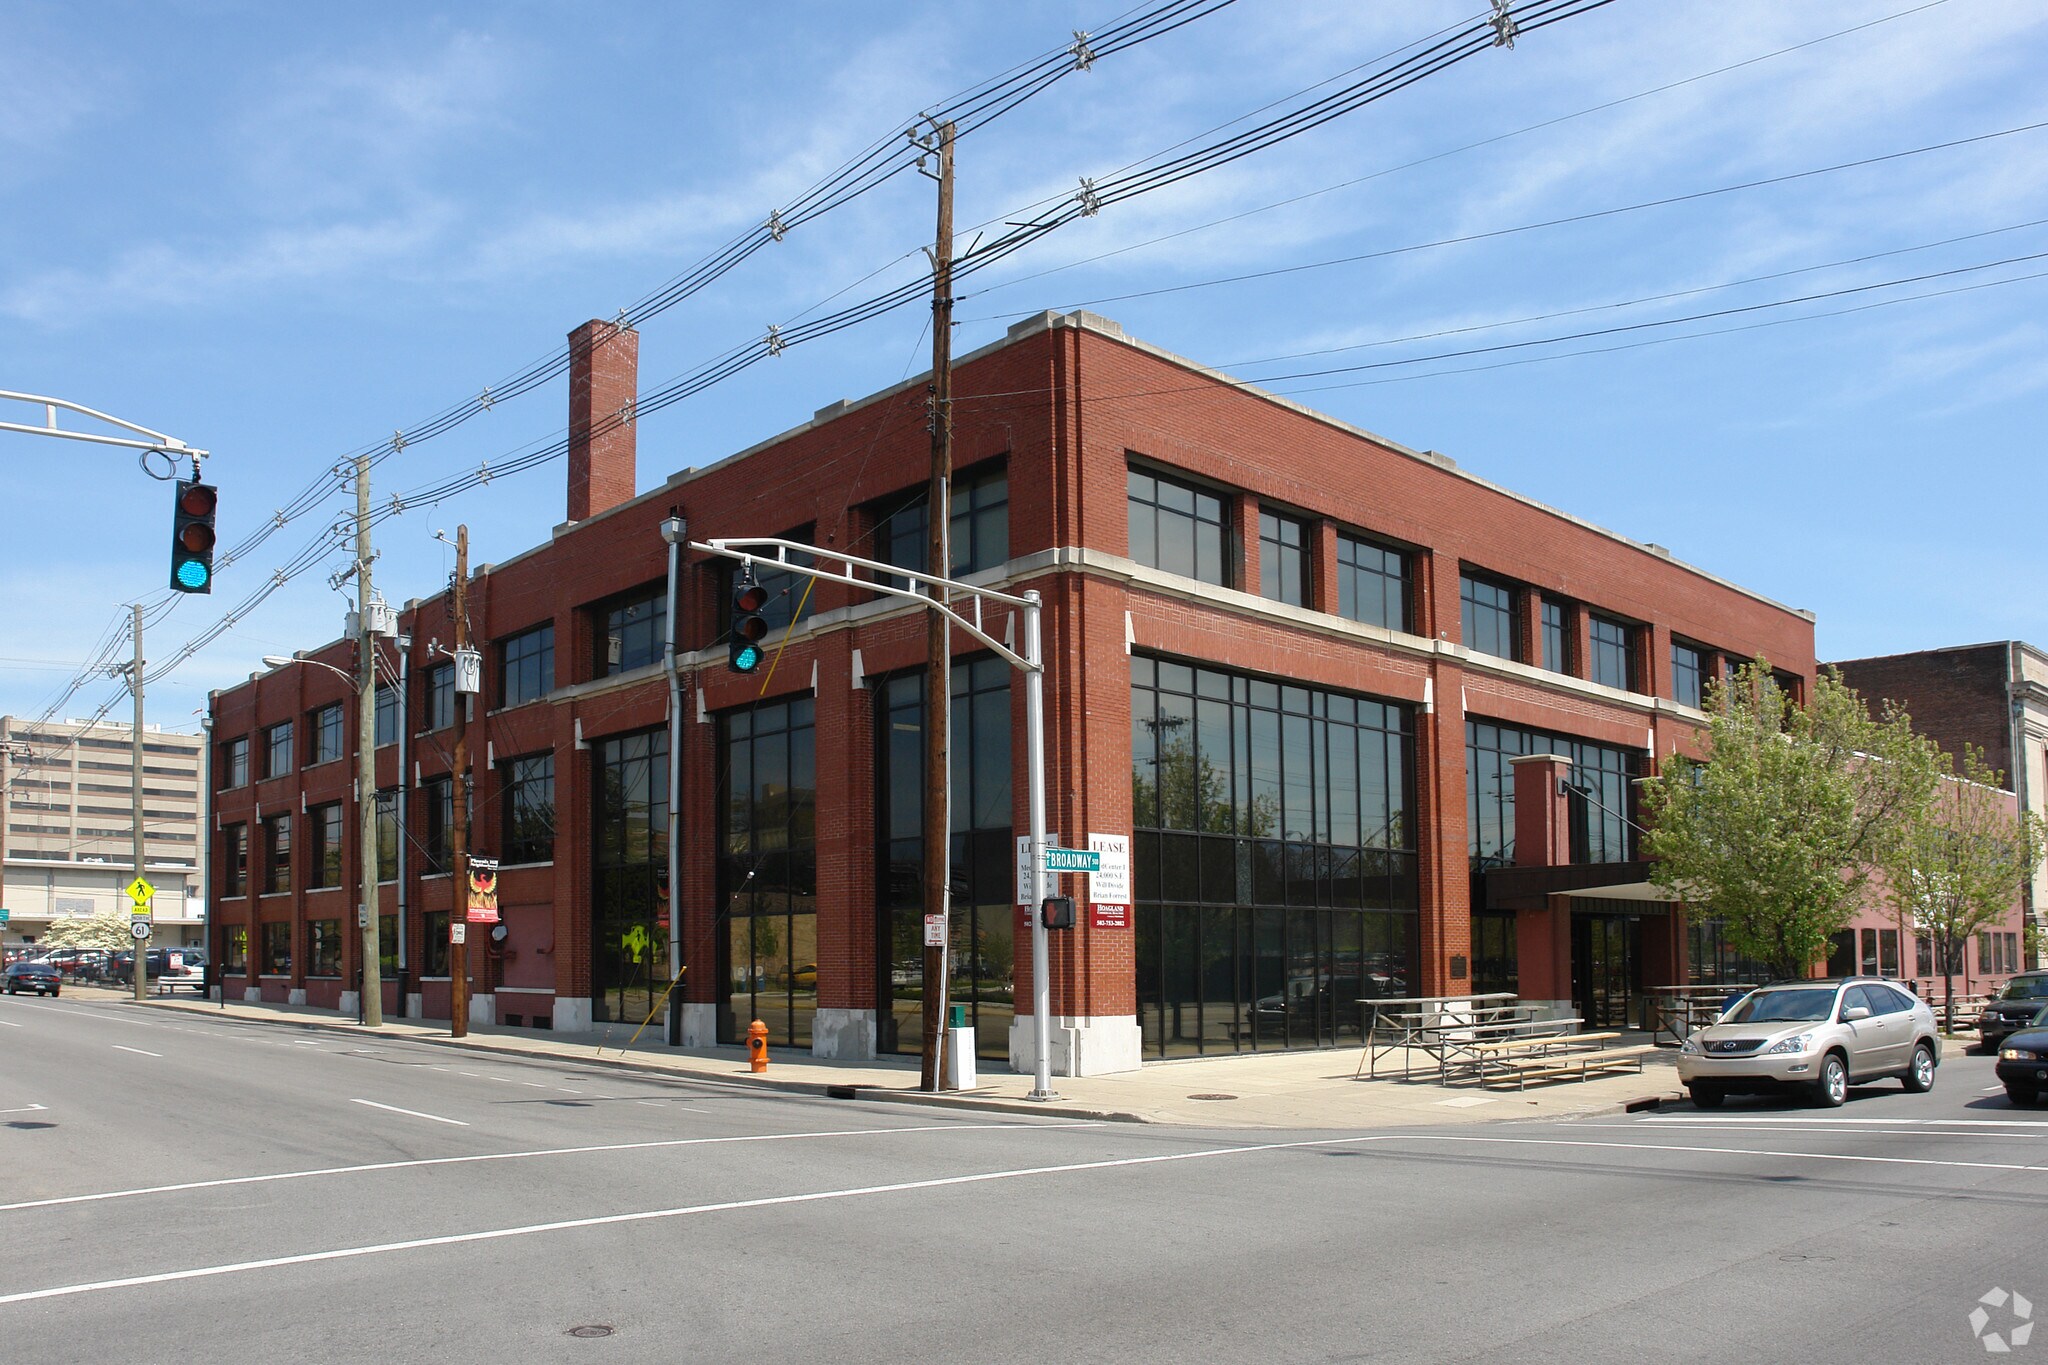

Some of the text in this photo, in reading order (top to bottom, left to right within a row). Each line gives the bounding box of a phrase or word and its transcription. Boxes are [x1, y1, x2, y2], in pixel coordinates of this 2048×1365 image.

[1093, 841, 1125, 853] LEASE
[1051, 852, 1092, 868] BROADWAY
[135, 926, 145, 935] 61
